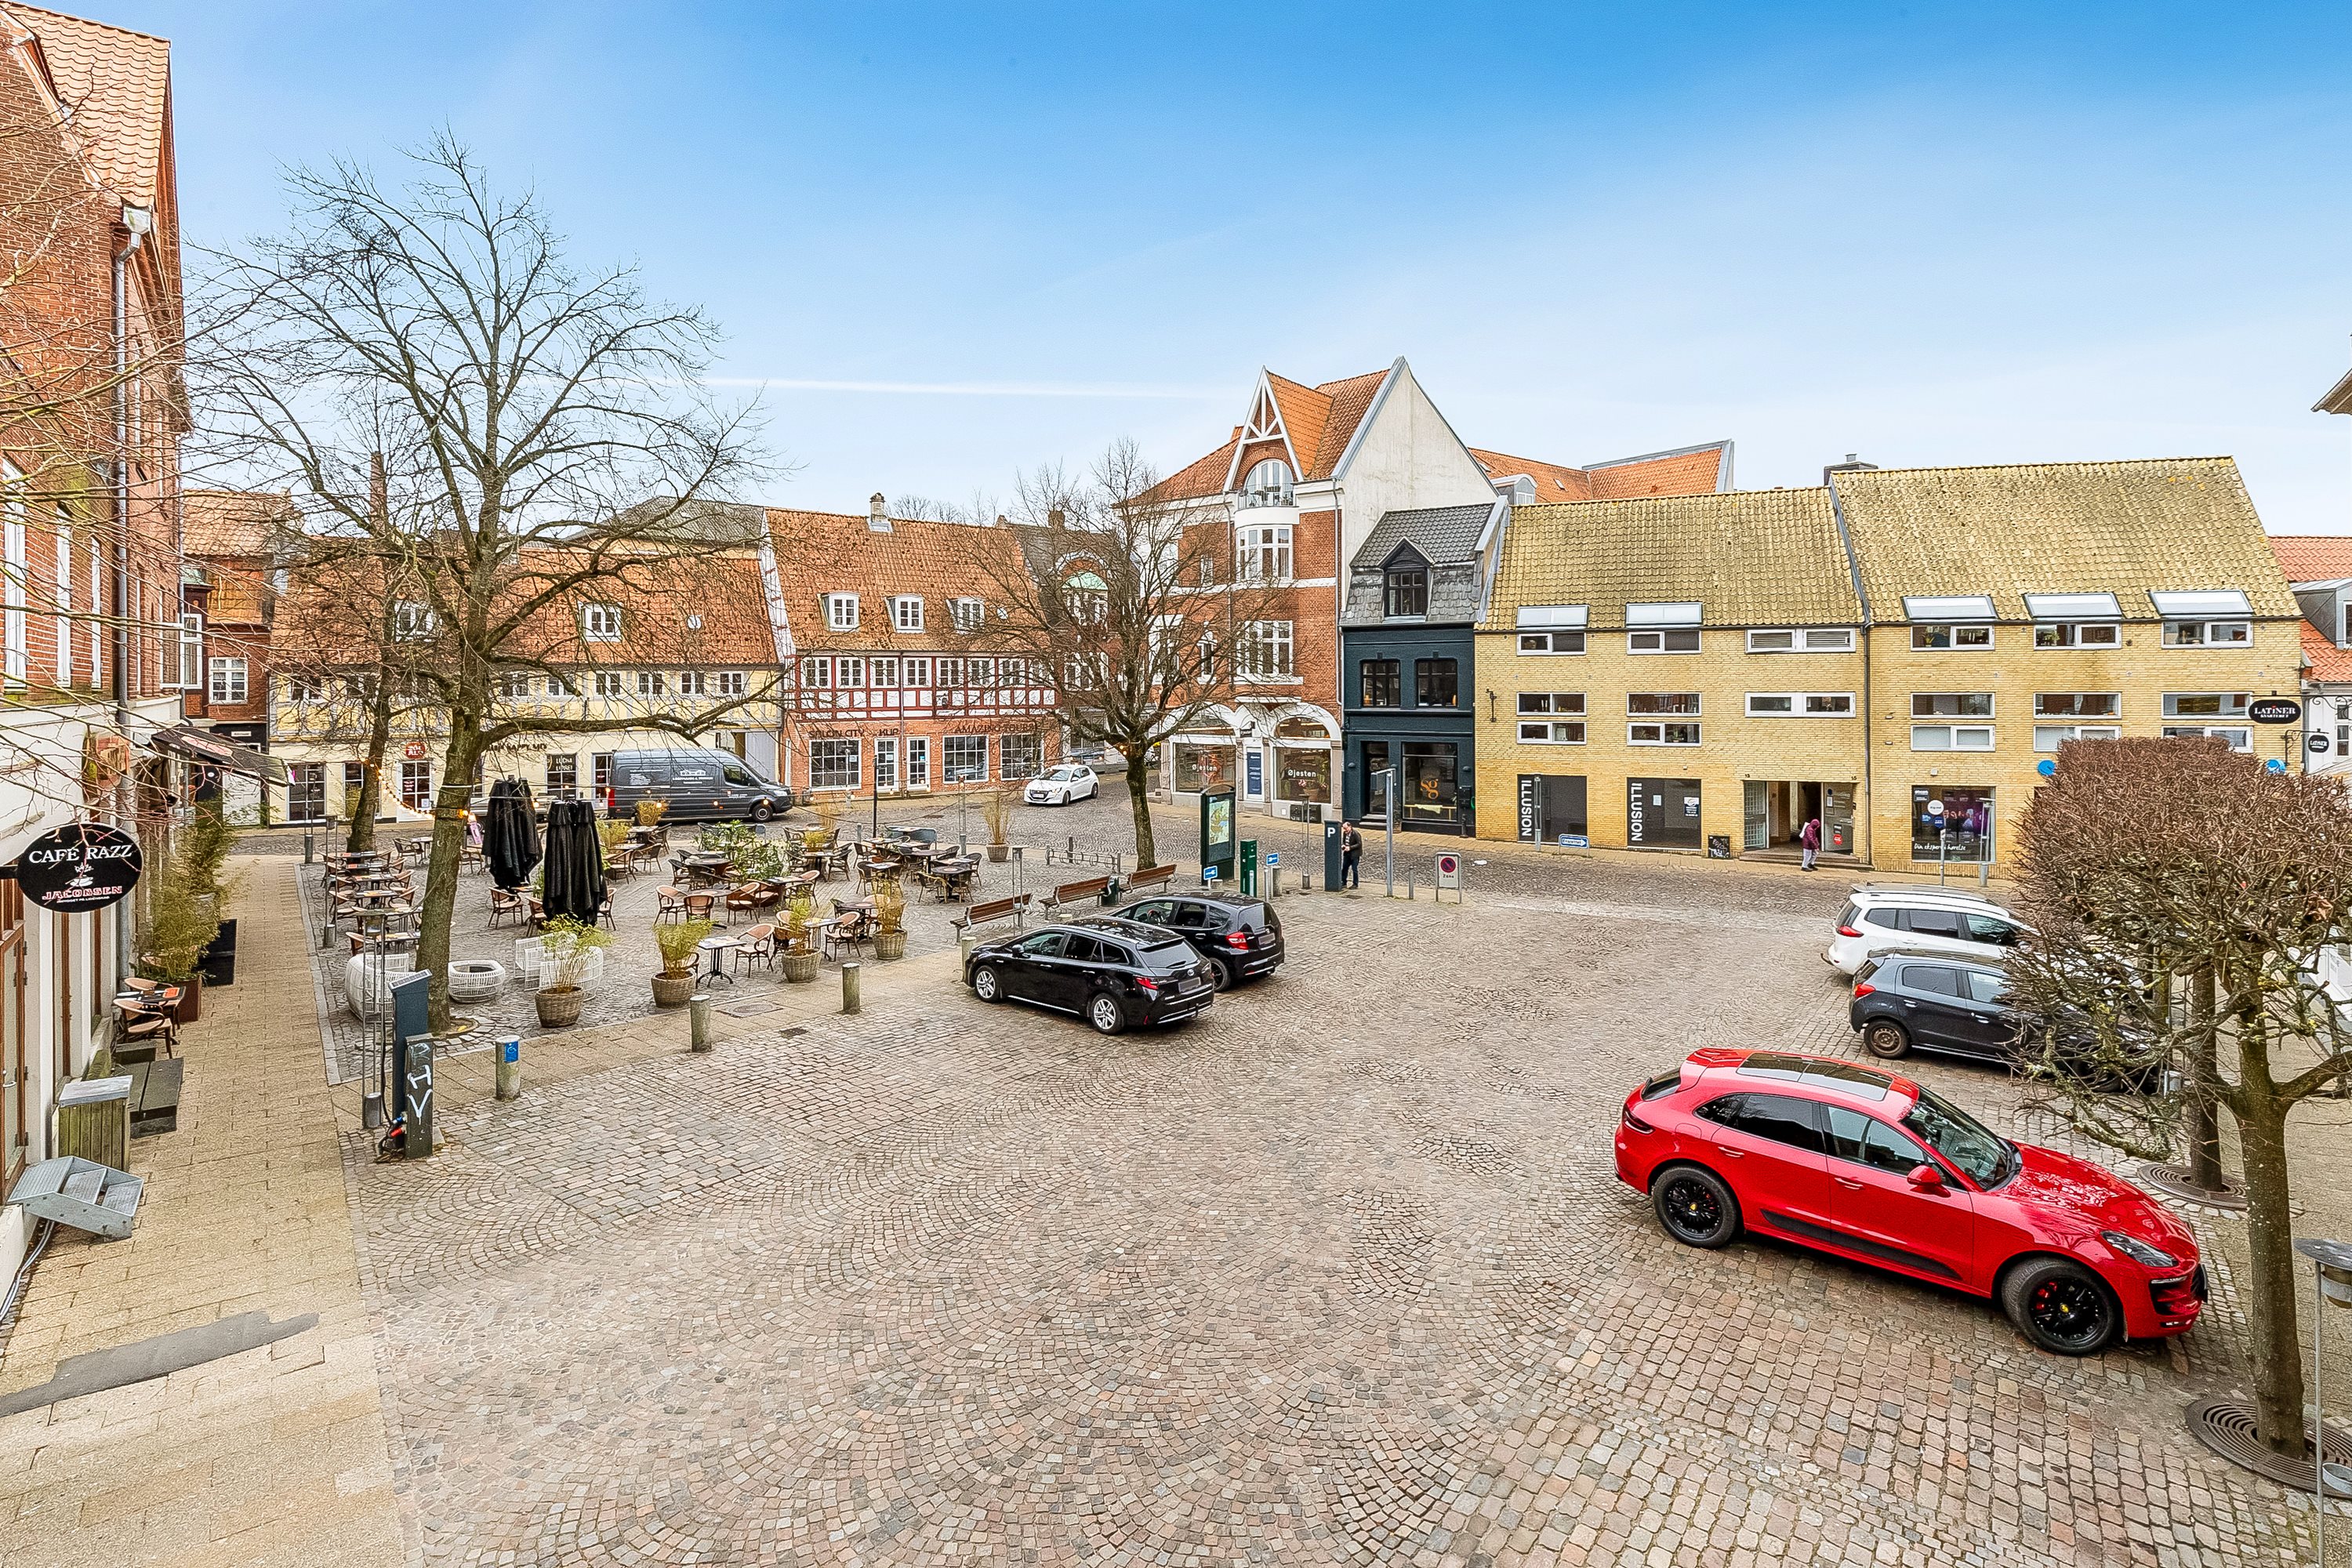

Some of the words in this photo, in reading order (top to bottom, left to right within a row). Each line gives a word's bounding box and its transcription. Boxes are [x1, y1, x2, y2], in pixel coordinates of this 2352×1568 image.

[1287, 769, 1316, 779] Øjesten
[1521, 779, 1532, 837] ILLUSION
[1631, 782, 1643, 841] ILLUSION
[1327, 827, 1336, 838] P
[86, 844, 132, 860] RAZZ
[42, 885, 122, 900] JACOBSEN
